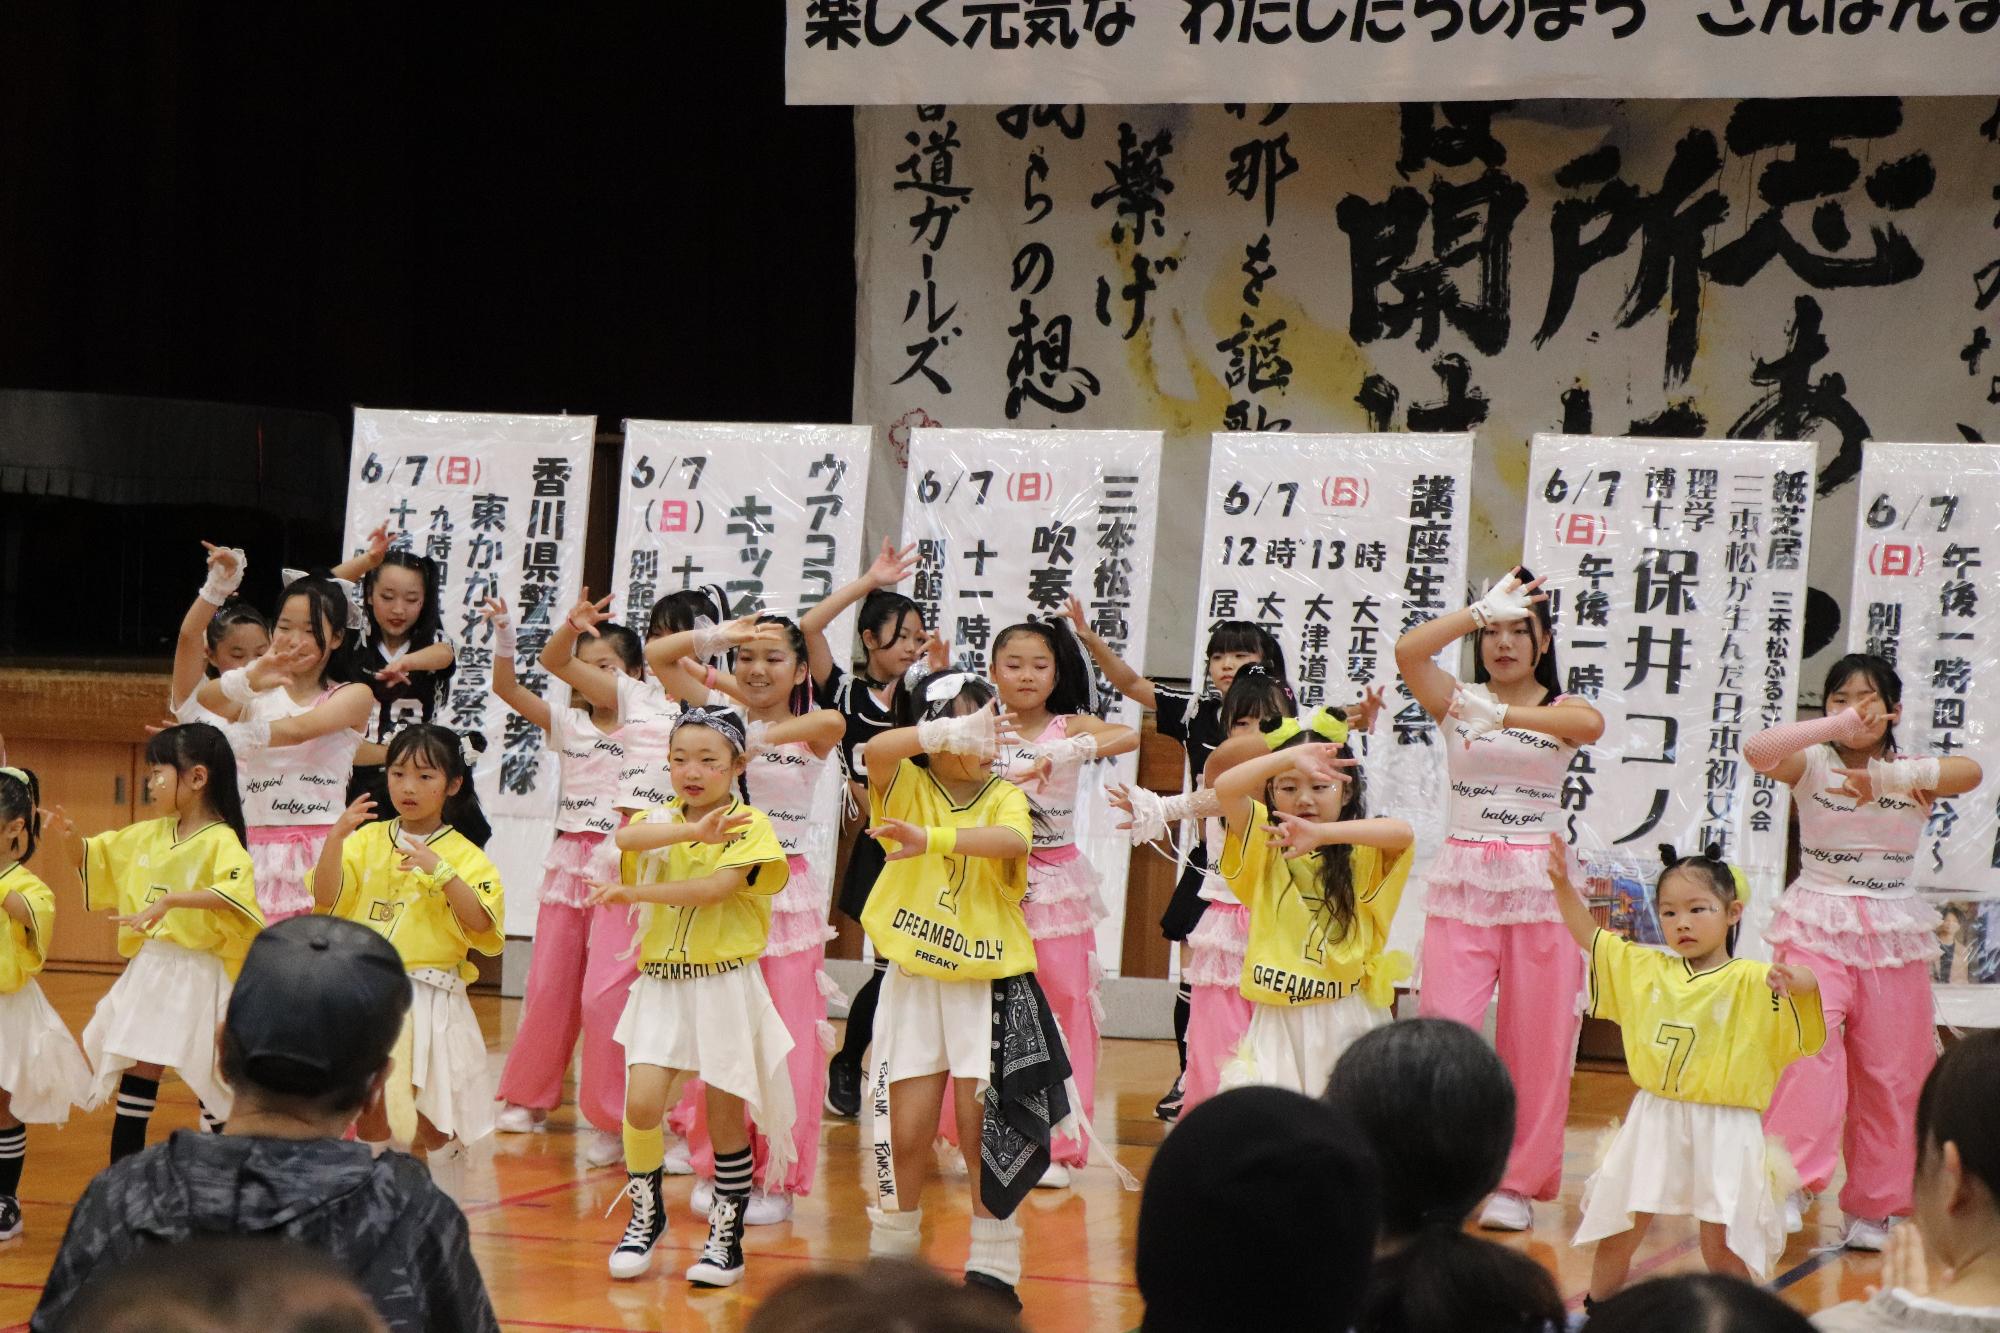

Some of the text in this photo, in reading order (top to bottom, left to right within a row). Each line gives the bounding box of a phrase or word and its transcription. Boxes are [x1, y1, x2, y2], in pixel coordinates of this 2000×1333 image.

[894, 104, 973, 395] 道ガールズ
[996, 104, 1100, 429] らの想
[1215, 103, 1298, 432] 那を謳
[631, 455, 707, 490] 6/7
[1544, 468, 1621, 507] 6/7
[1682, 468, 1718, 532] 理学
[645, 499, 704, 533] (日)
[797, 453, 847, 617] ウアココ
[1556, 512, 1607, 546] (日)
[1767, 470, 1809, 570] 紙芝居
[1867, 493, 1959, 532] 6/7
[1027, 521, 1077, 625] 吹奏
[1869, 543, 1924, 577] (日)
[449, 493, 509, 736] 東かがわ警察
[1613, 547, 1700, 845] 保井コノ
[271, 799, 331, 814] baby girl
[1481, 807, 1546, 826] baby girl
[914, 949, 959, 972] FREAKY
[1656, 1023, 1696, 1092] 7
